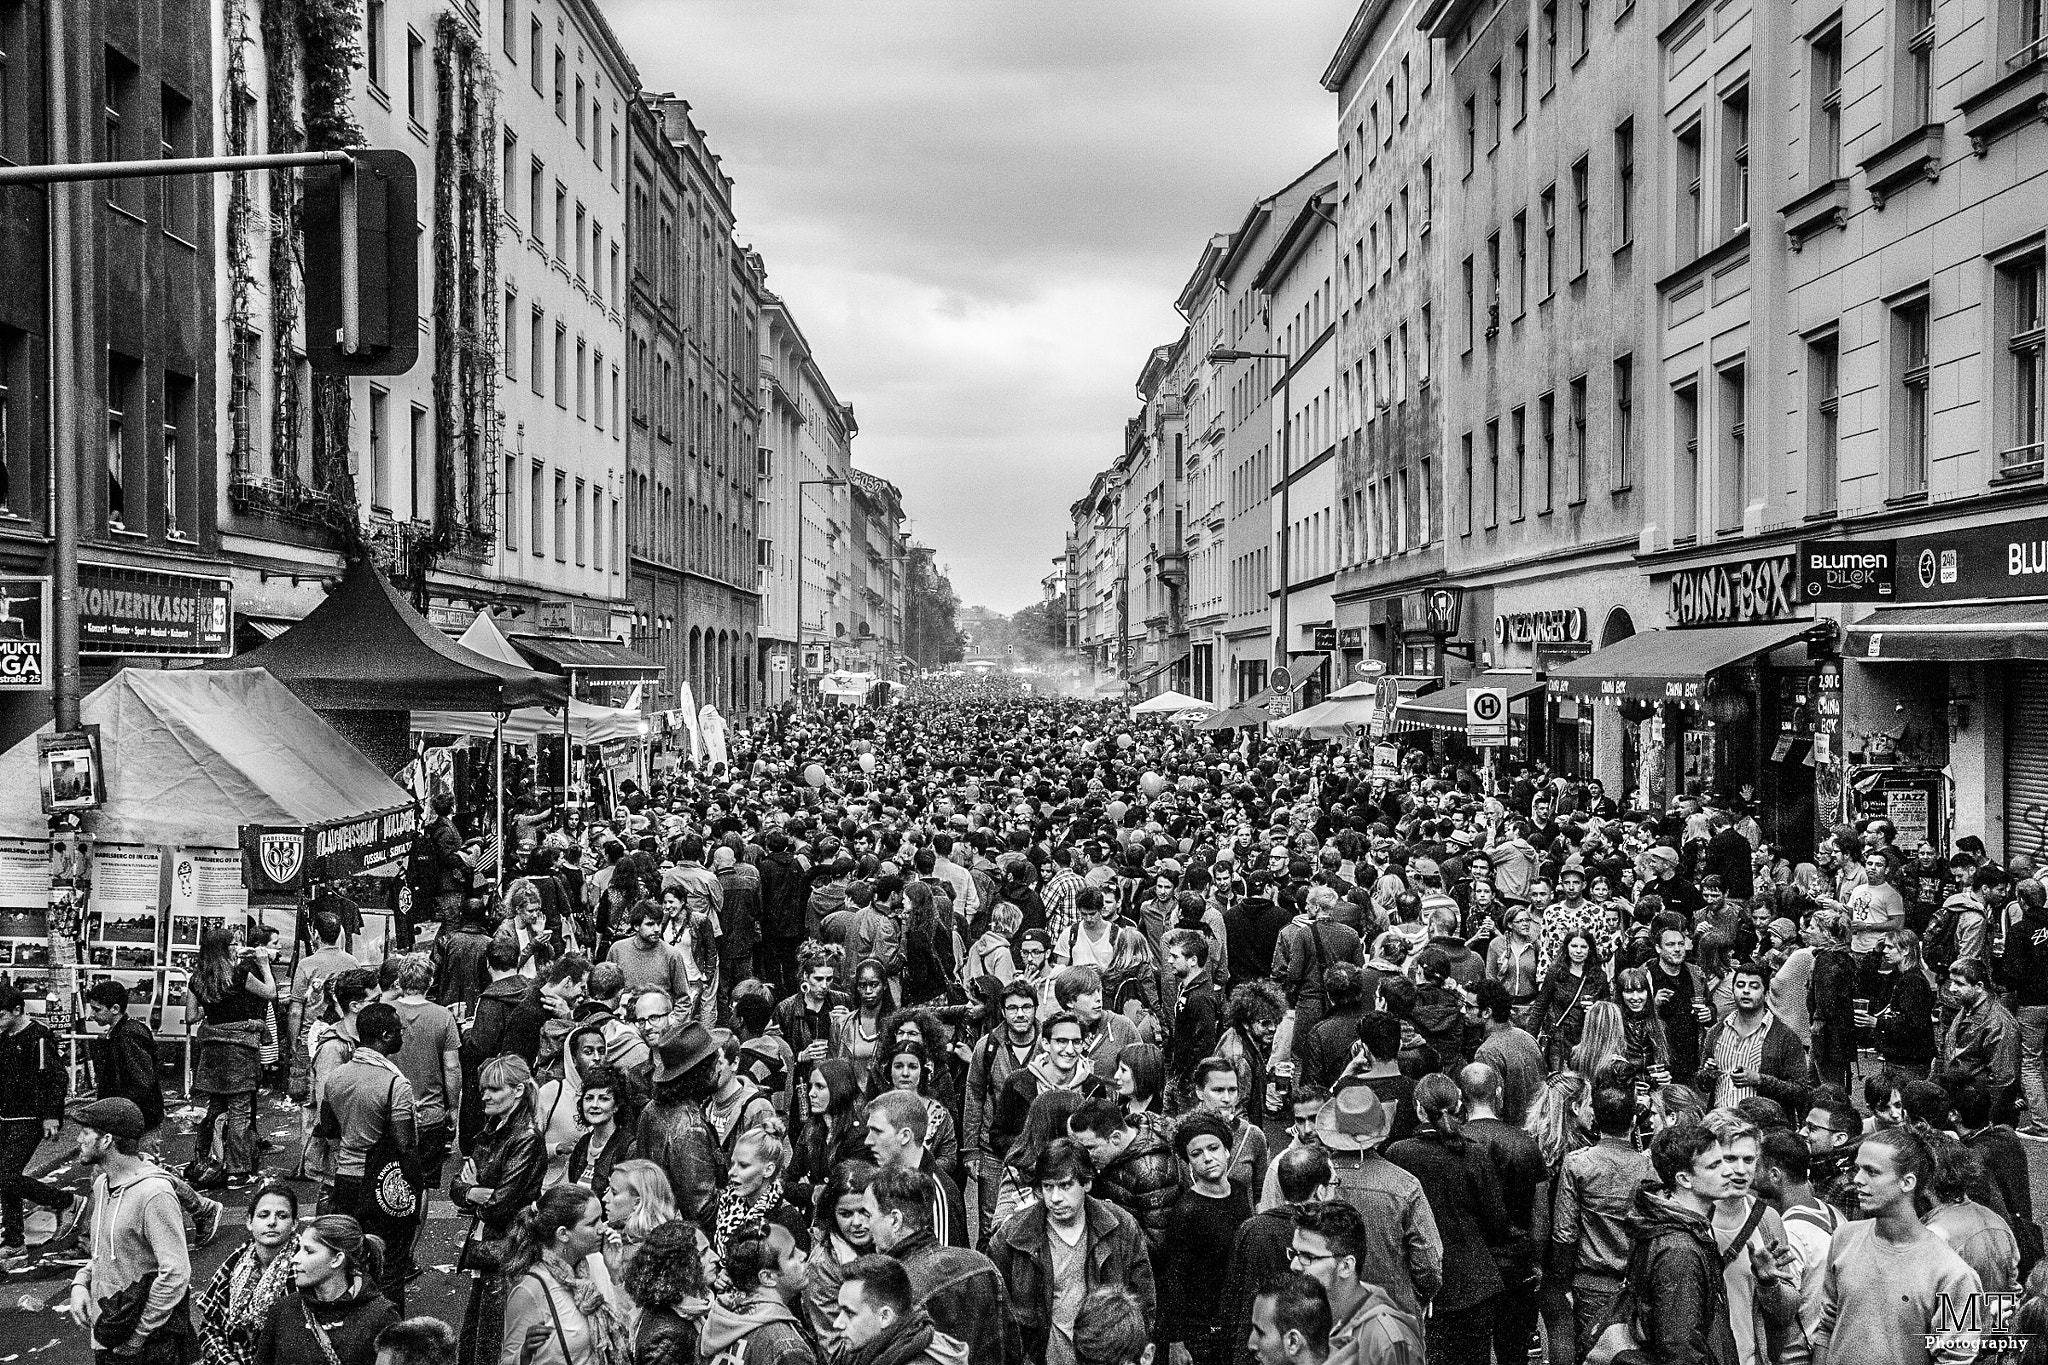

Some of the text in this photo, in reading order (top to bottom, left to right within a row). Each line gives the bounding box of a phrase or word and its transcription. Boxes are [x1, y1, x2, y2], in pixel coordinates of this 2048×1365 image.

[77, 586, 195, 623] KONZERTKASSE
[0, 655, 41, 675] GA
[29, 675, 41, 683] 25
[1481, 699, 1495, 714] H
